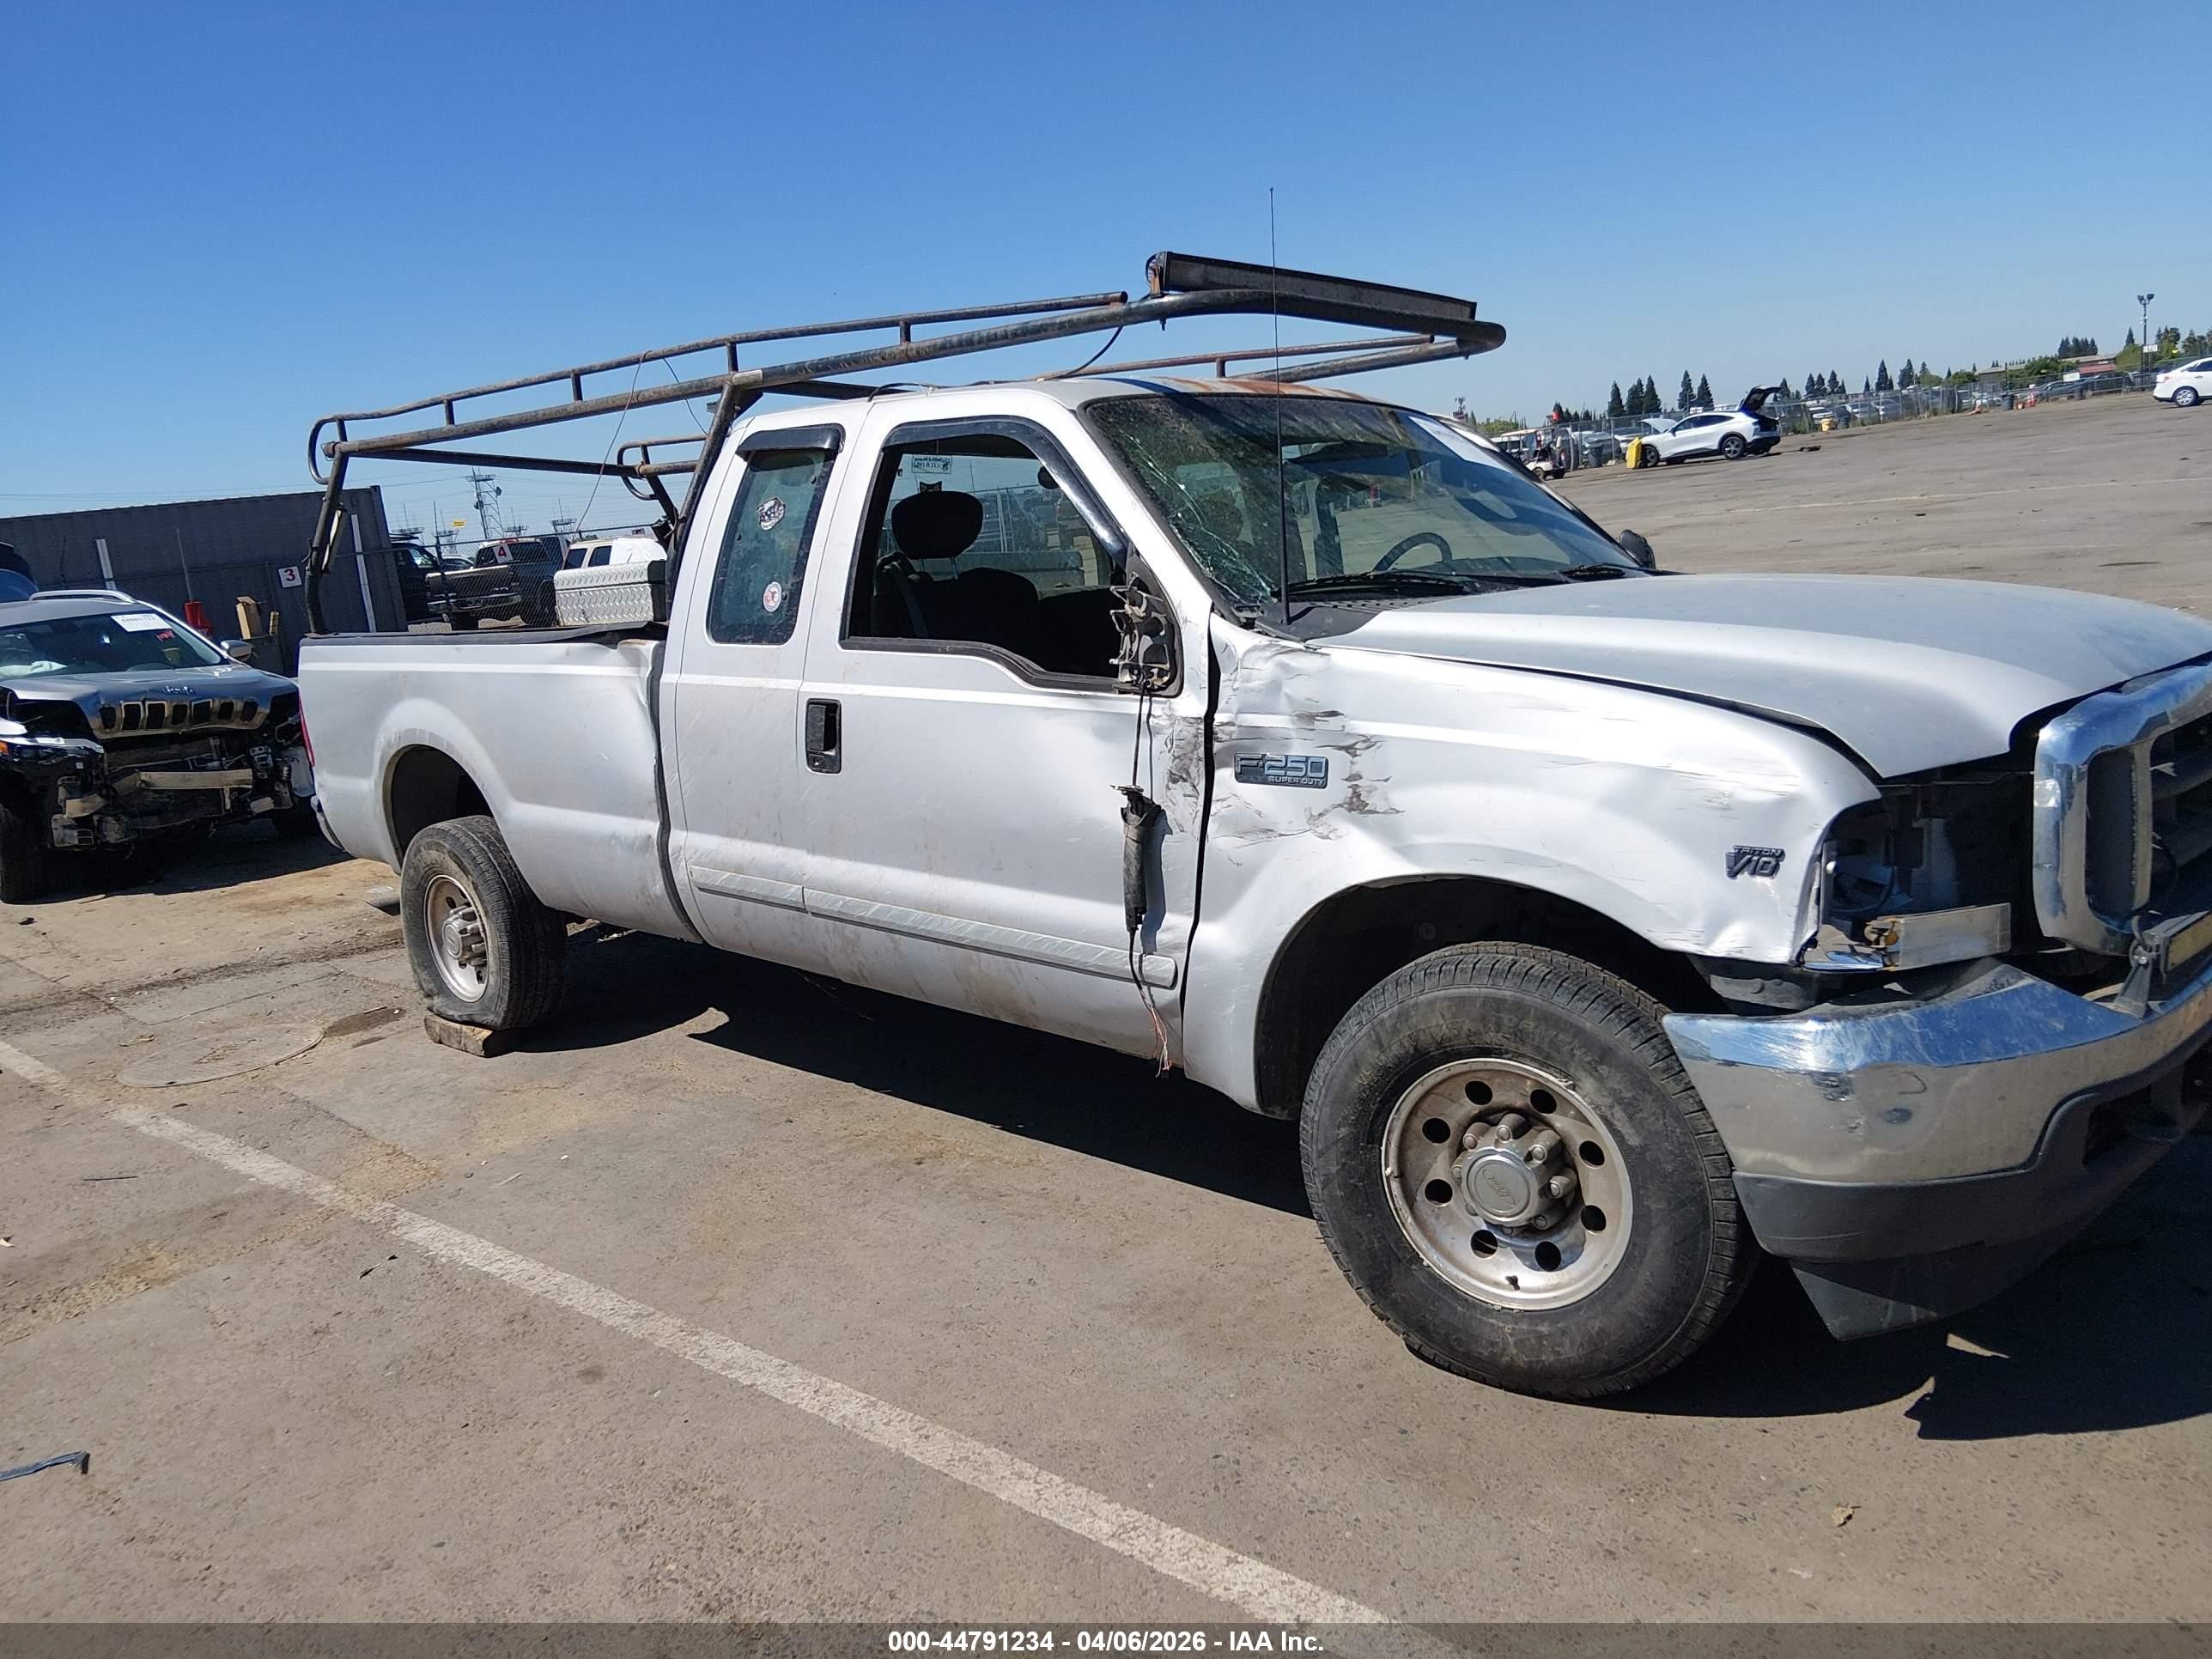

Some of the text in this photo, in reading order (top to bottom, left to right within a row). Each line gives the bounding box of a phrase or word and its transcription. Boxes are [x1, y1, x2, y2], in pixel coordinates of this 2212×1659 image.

[498, 545, 507, 557] 4
[284, 568, 295, 581] 3
[1268, 776, 1326, 787] SUPER DUTY
[1733, 846, 1783, 857] TRITON
[1726, 854, 1780, 878] V10
